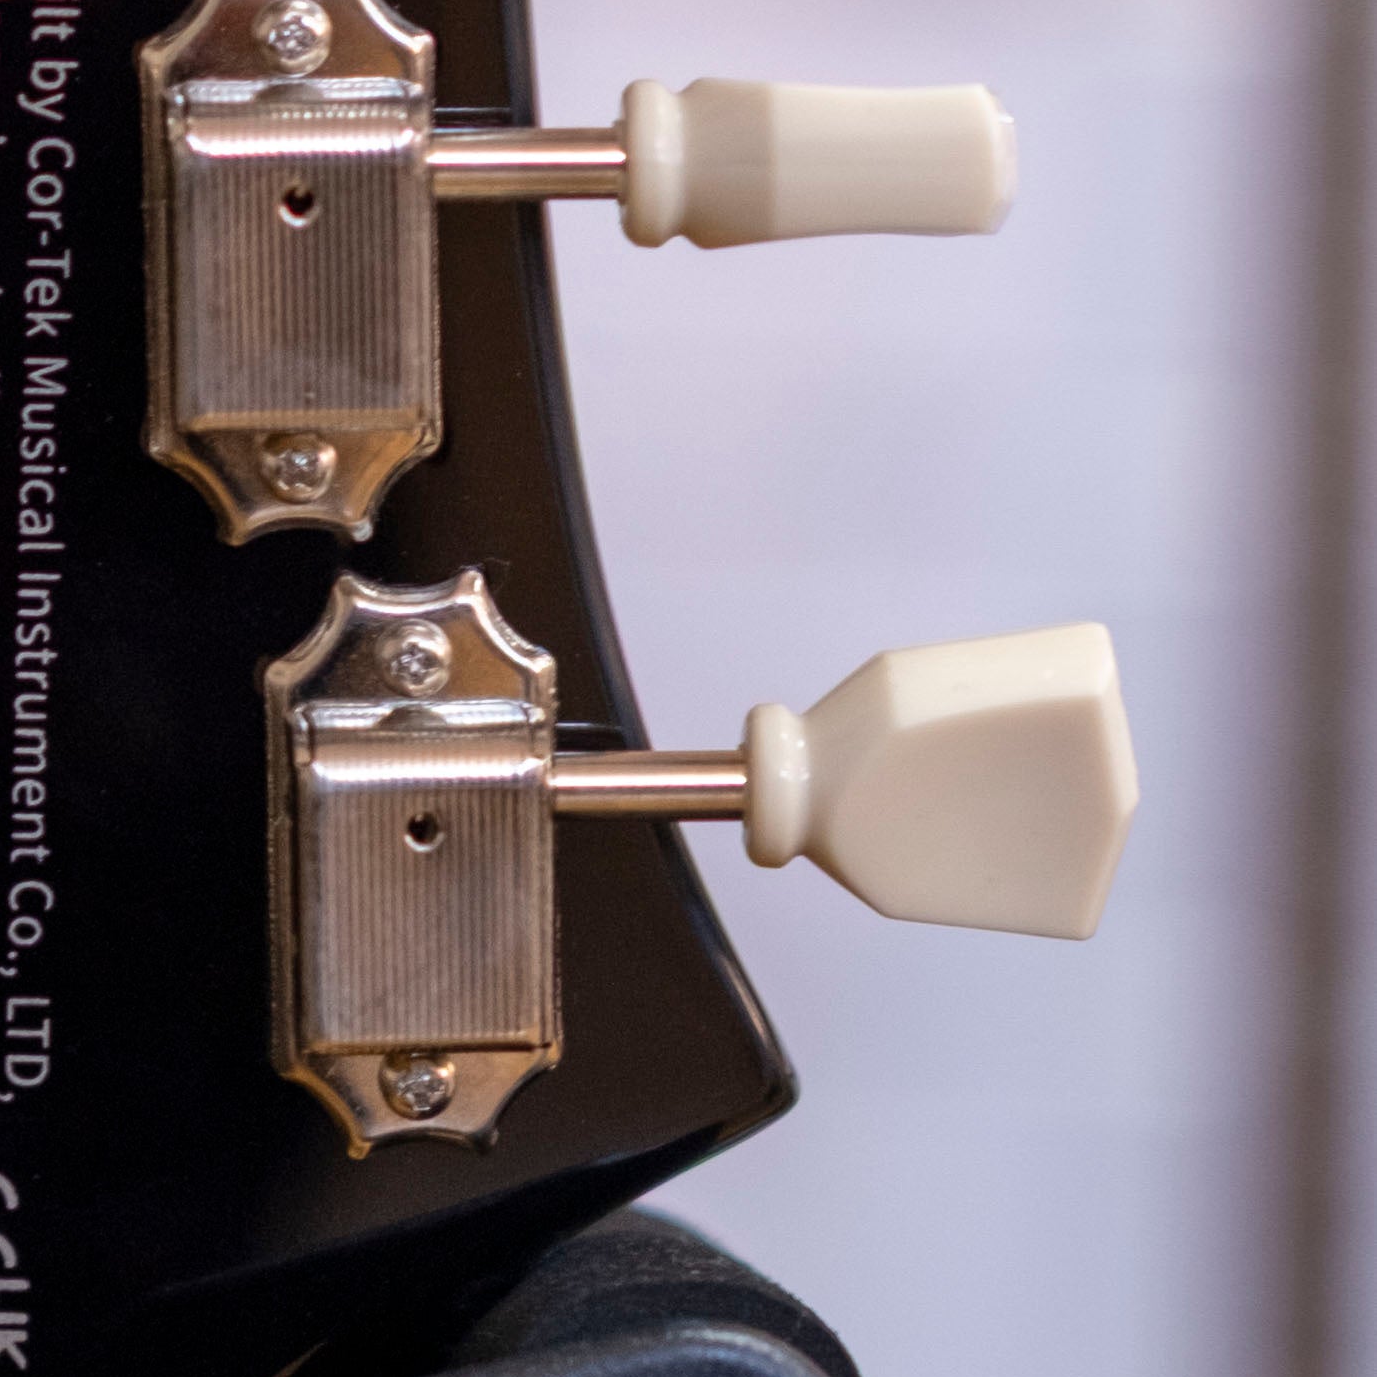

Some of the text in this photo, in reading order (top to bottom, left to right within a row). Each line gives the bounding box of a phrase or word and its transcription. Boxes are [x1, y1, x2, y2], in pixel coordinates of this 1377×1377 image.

[17, 60, 80, 122] by
[24, 137, 75, 337] Cor-Tek
[17, 356, 68, 552] Musical
[9, 572, 62, 862] Instrument
